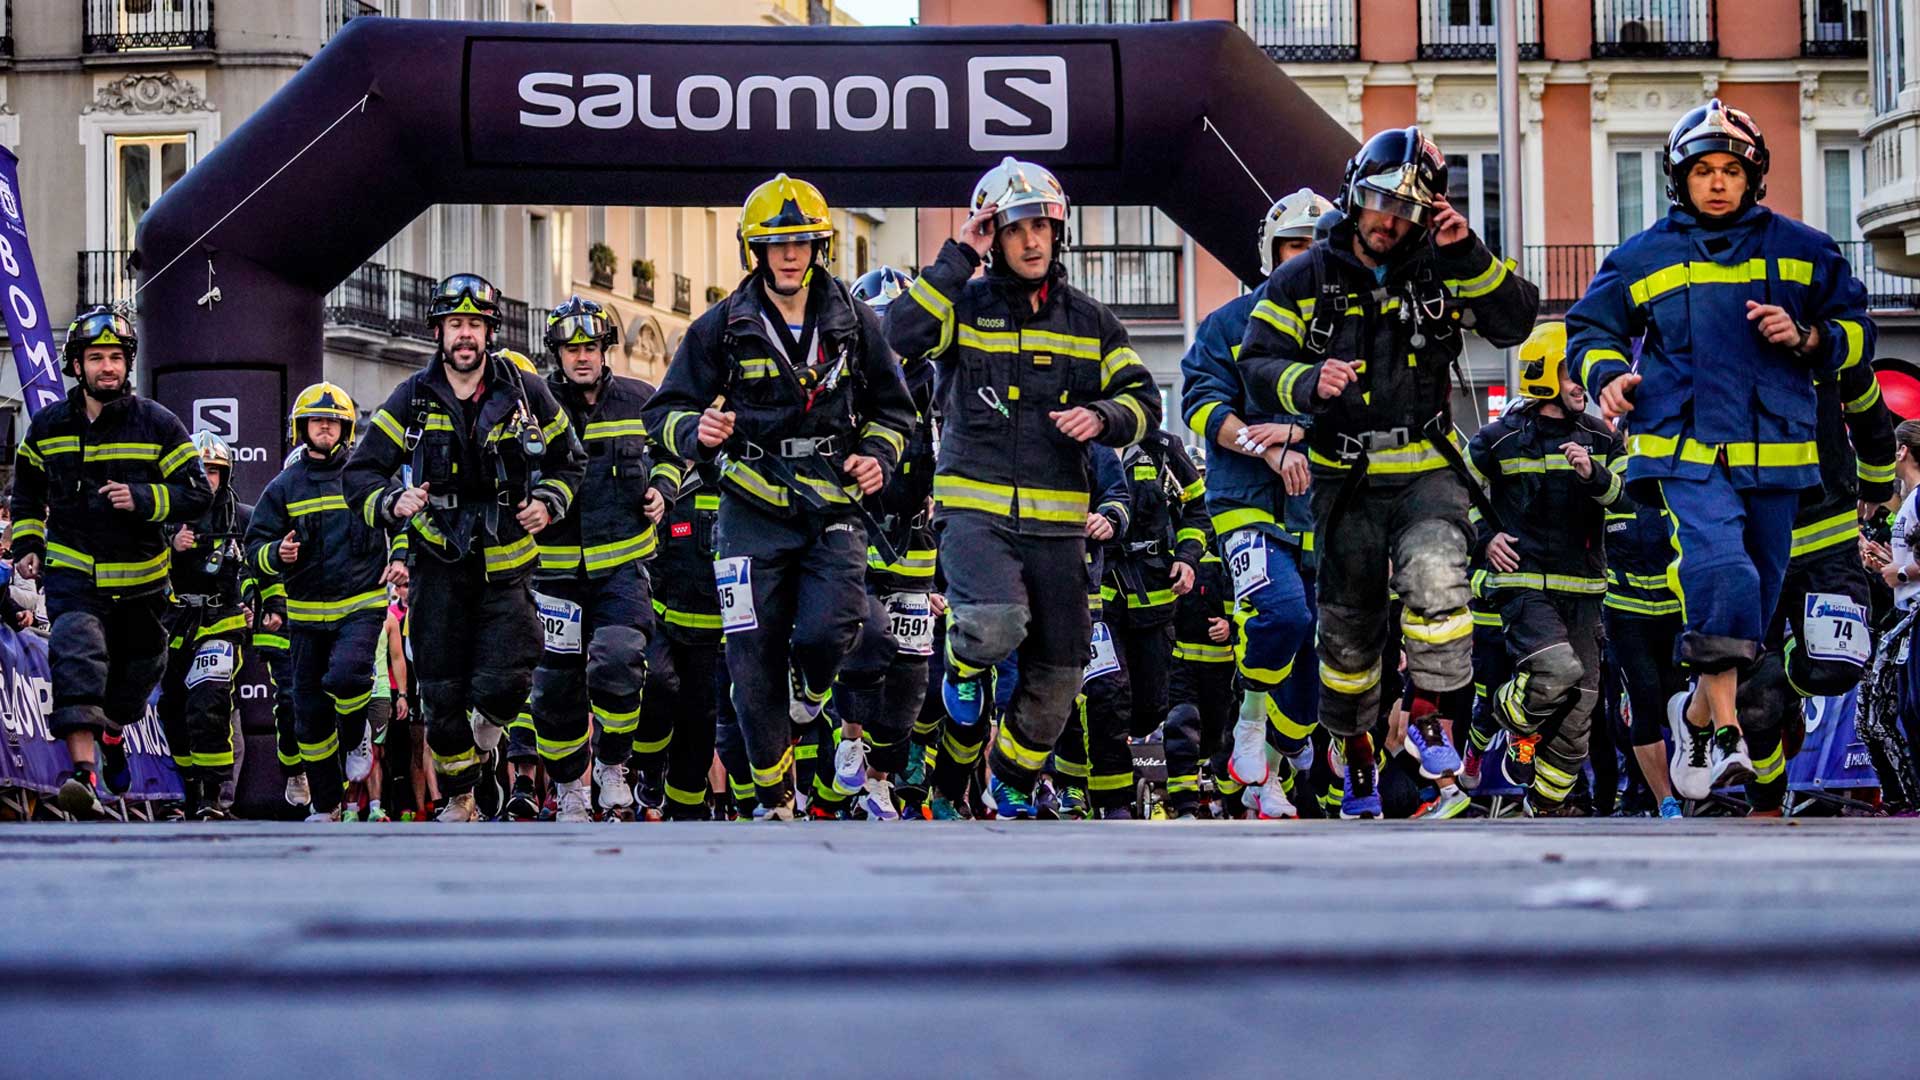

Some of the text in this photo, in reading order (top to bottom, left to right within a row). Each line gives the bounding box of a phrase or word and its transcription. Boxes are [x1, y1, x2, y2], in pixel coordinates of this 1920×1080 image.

[1231, 551, 1251, 578] 39
[891, 616, 929, 637] 1591
[1832, 619, 1853, 641] 74
